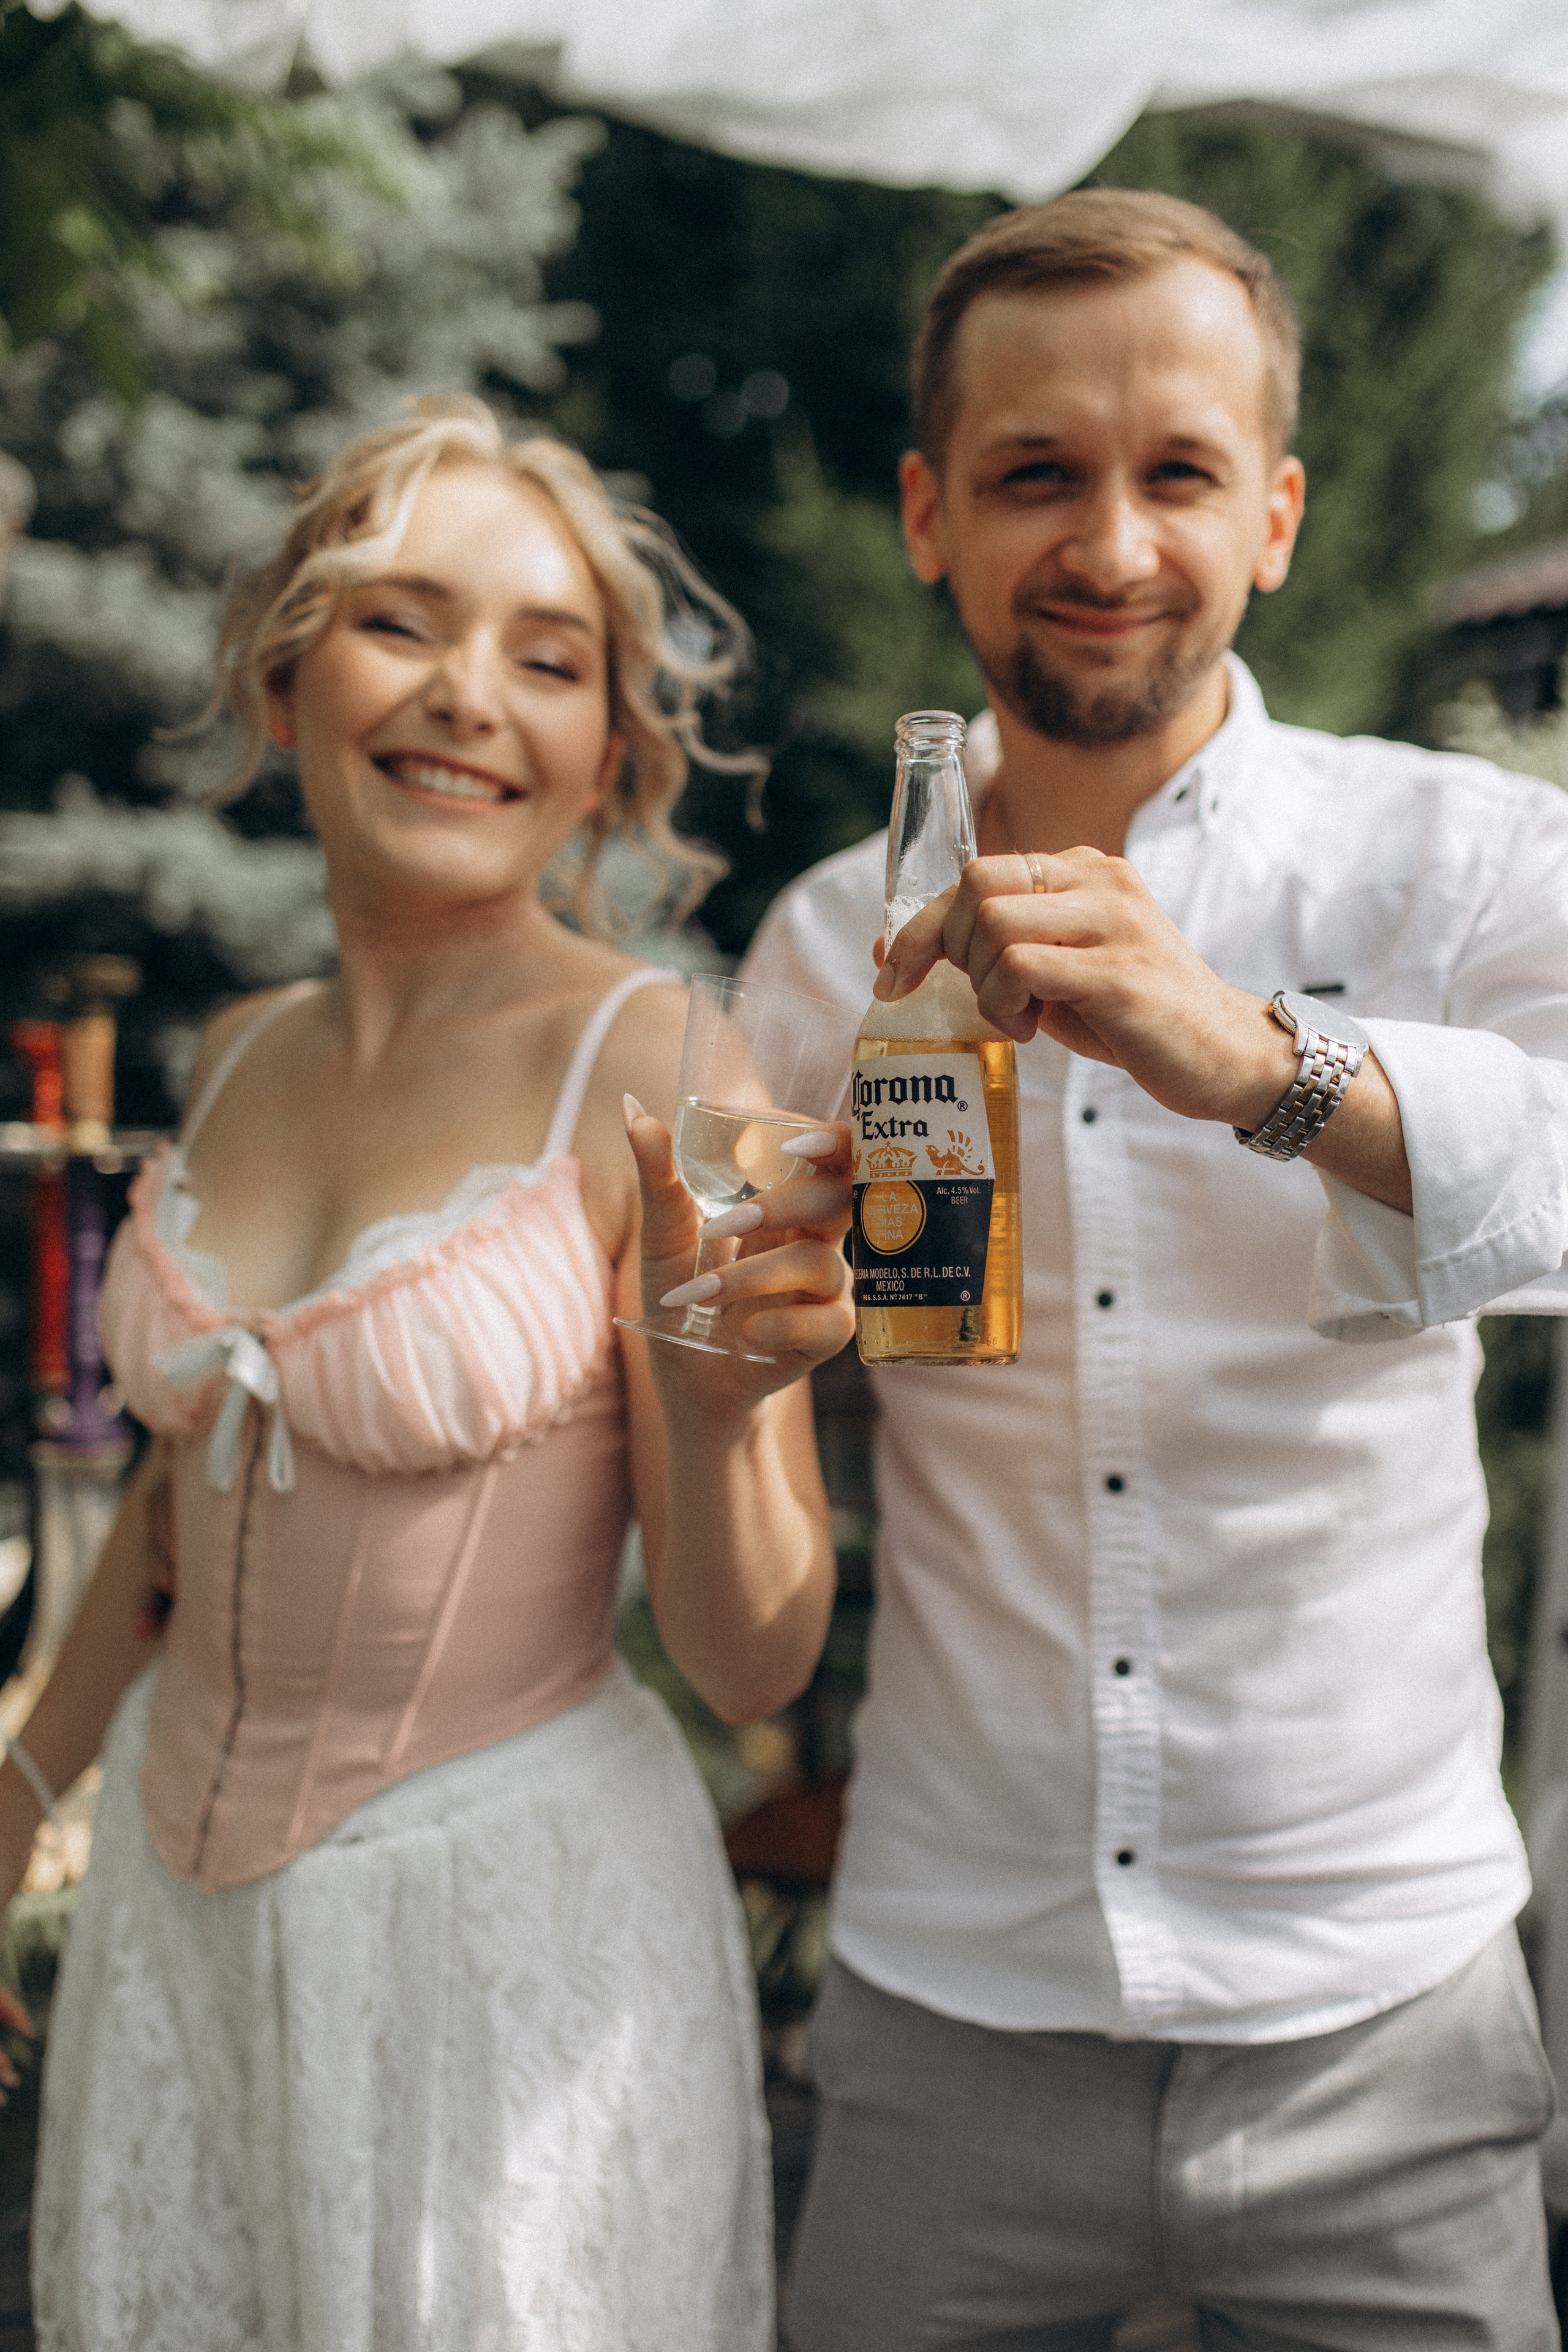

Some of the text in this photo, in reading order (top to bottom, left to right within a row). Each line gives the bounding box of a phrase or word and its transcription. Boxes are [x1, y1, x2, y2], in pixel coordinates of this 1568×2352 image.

[851, 1069, 959, 1121] Corona
[861, 1110, 929, 1140] Extra
[881, 1191, 897, 1202] LA
[867, 1204, 919, 1216] CERVEZA
[878, 1216, 903, 1227] MAS
[878, 1229, 904, 1240] FINA
[854, 1266, 971, 1280] ECERIA MODELO, S. DE R.L. DE C.V.
[876, 1280, 905, 1291] MEXICO
